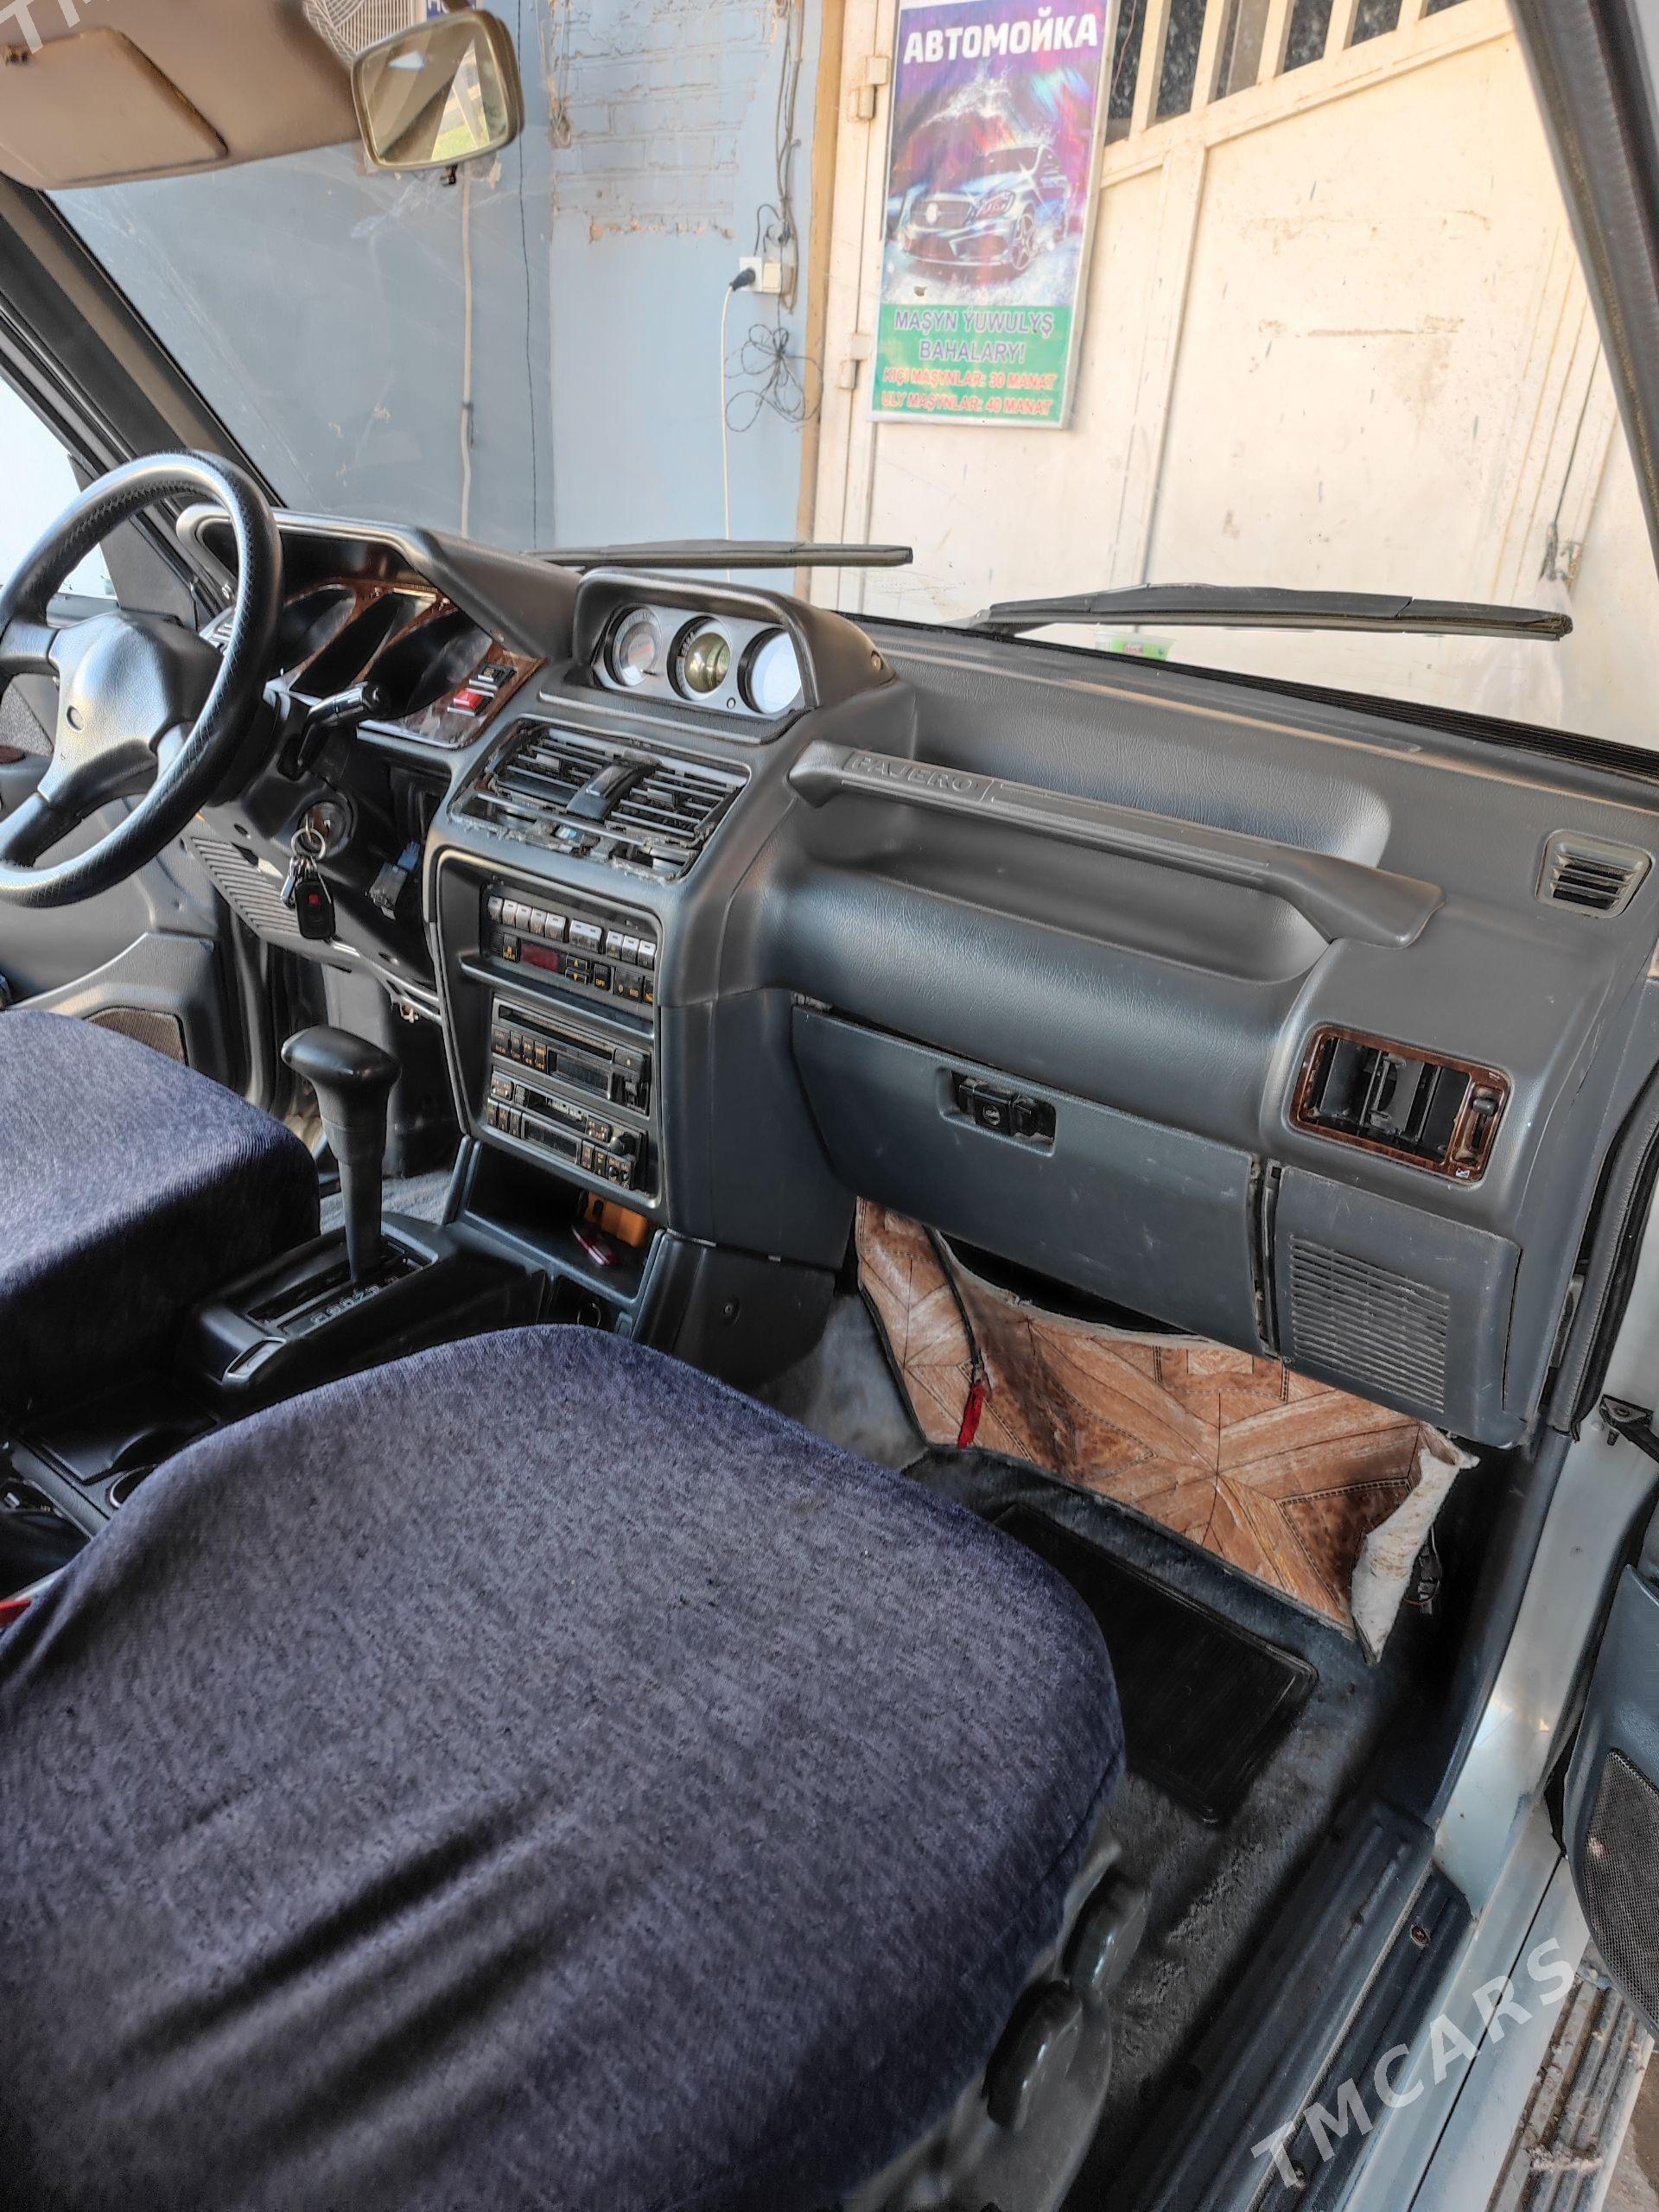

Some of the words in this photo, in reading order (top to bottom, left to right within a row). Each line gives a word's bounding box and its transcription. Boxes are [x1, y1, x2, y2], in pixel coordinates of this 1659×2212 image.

[903, 6, 1097, 64] АВТОМОЙКА
[895, 311, 957, 335] MAŞYN
[918, 339, 1026, 364] BAHALARY!
[1007, 372, 1057, 390] MANAT
[1003, 397, 1052, 416] MANAT
[851, 756, 978, 792] PAJERO
